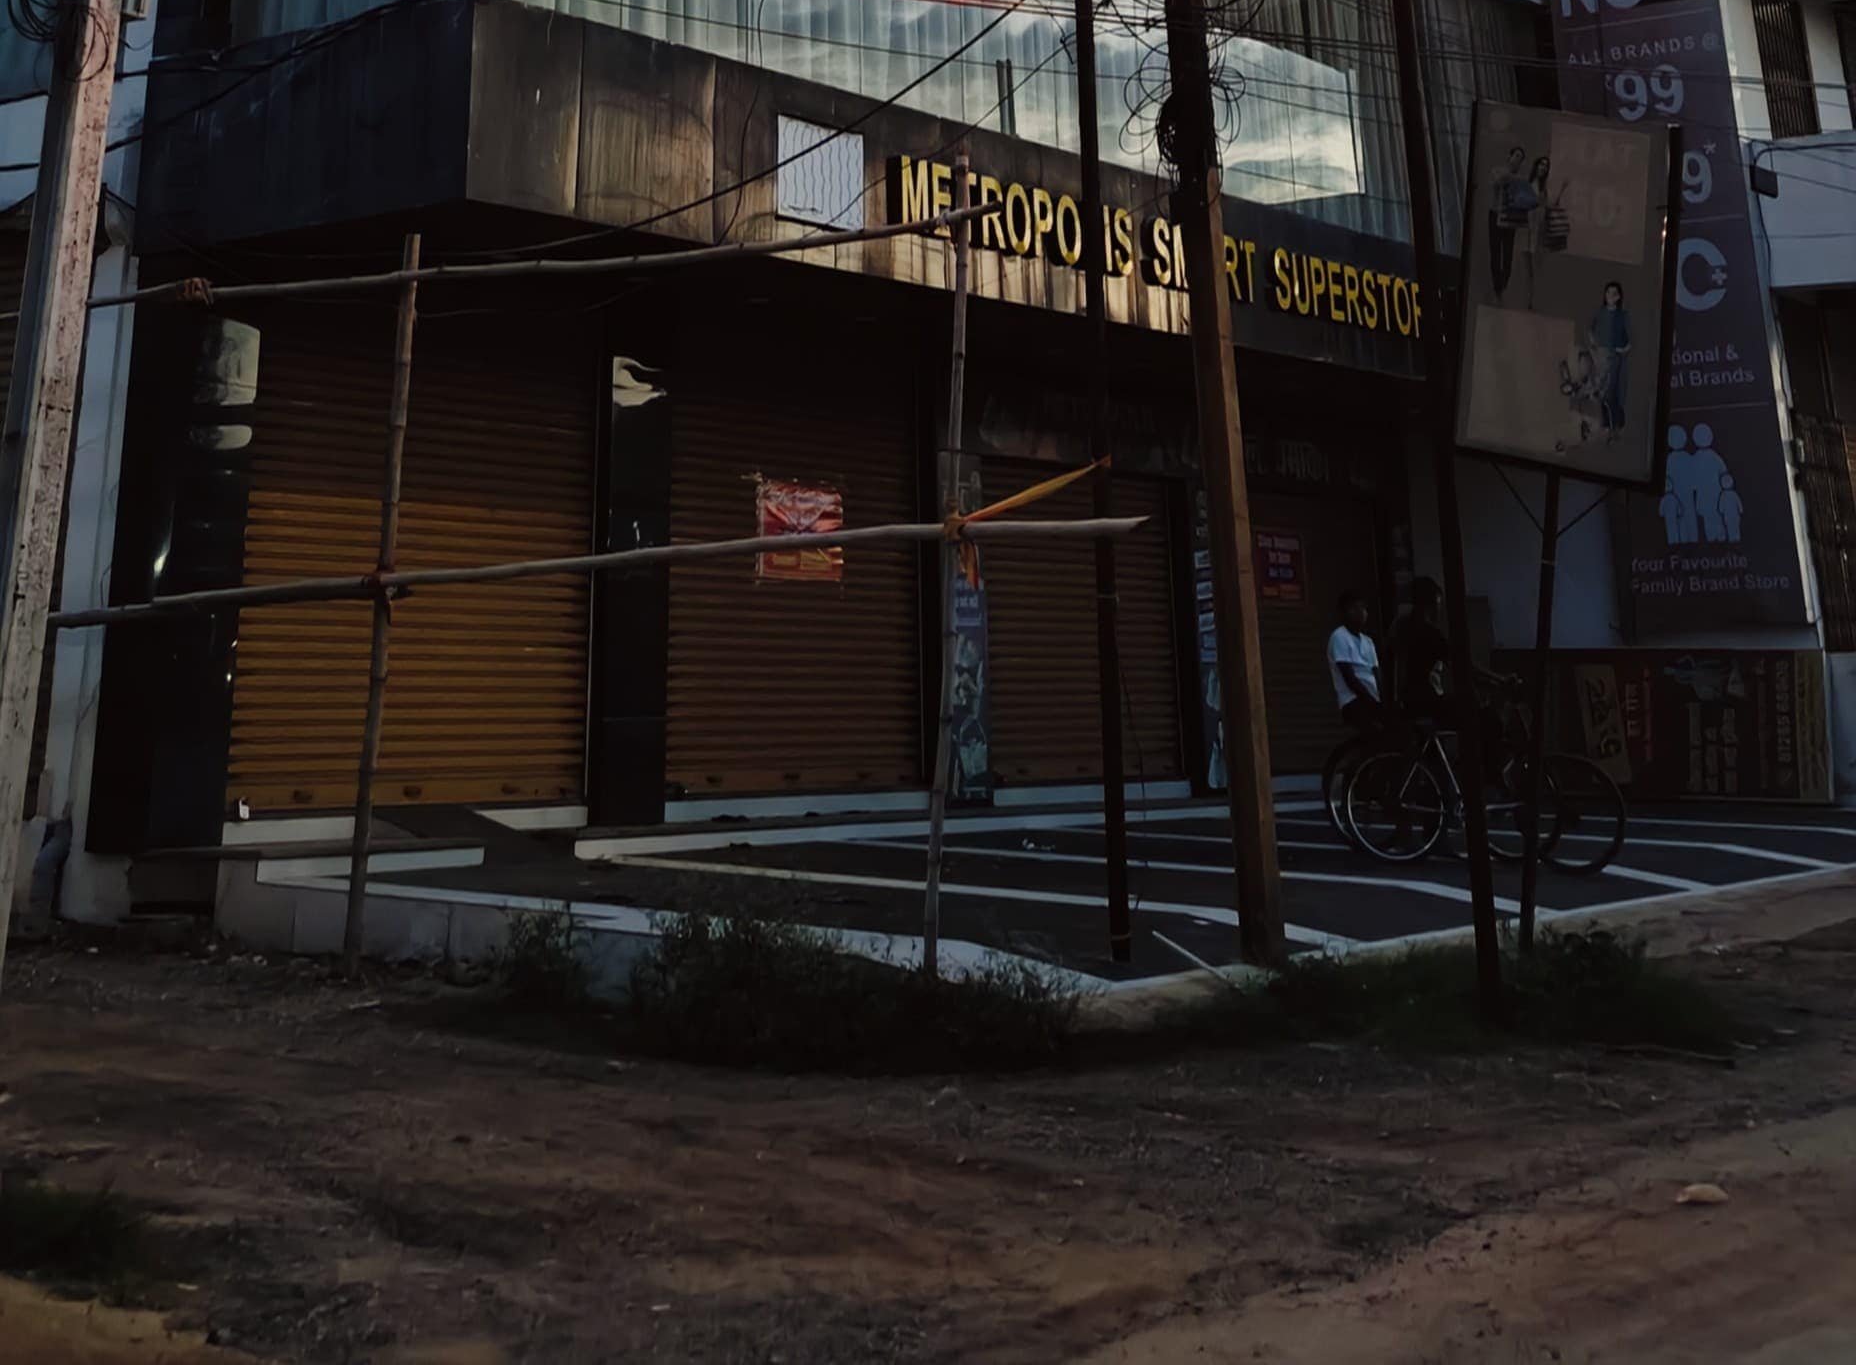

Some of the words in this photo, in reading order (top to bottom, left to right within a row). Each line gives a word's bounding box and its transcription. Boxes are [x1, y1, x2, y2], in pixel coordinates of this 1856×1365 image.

[1610, 35, 1696, 62] BRANDS
[901, 154, 1134, 277] MEROPOIS
[1152, 216, 1256, 304] SMRT
[1273, 245, 1435, 341] SUPERSTOR
[1690, 367, 1756, 388] Brands
[1670, 550, 1749, 571] Favourite
[1689, 574, 1741, 593] Brand
[1744, 573, 1790, 591] Store
